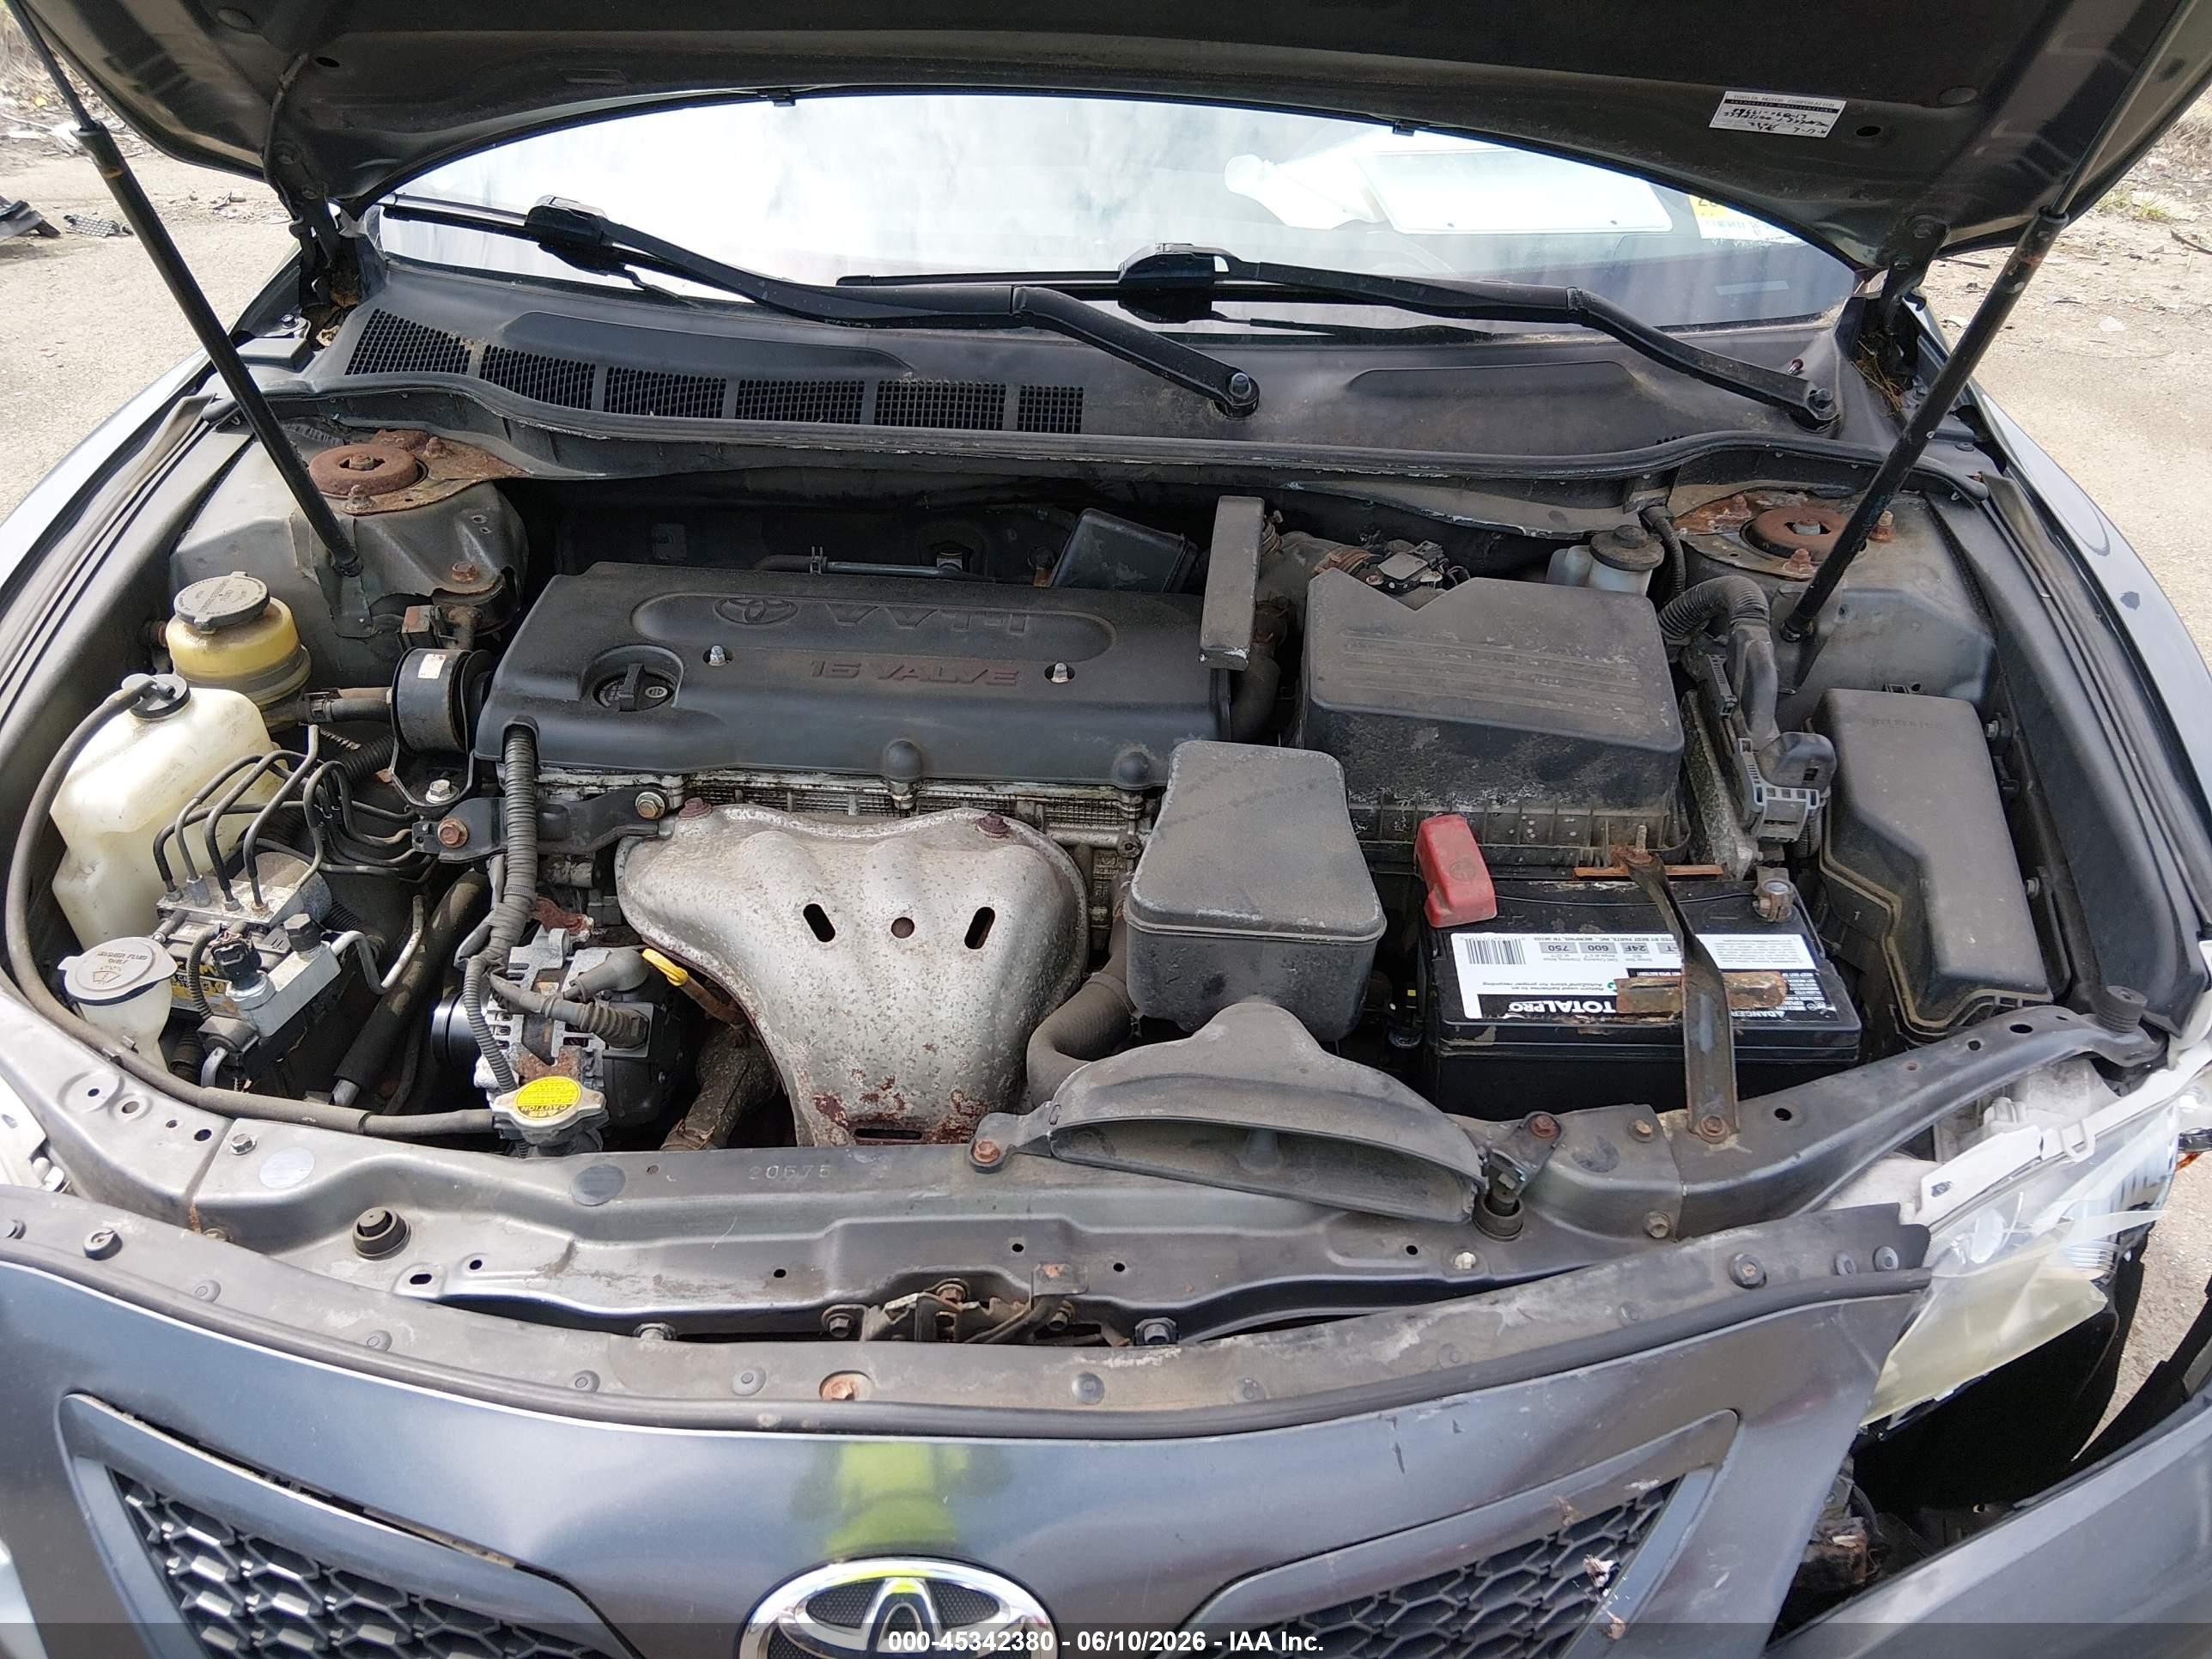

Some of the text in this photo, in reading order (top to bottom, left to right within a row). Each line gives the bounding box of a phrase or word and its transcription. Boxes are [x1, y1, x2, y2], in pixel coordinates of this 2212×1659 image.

[810, 660, 1019, 687] 16 VALVE
[1508, 1000, 1616, 1012] TOTALPRO
